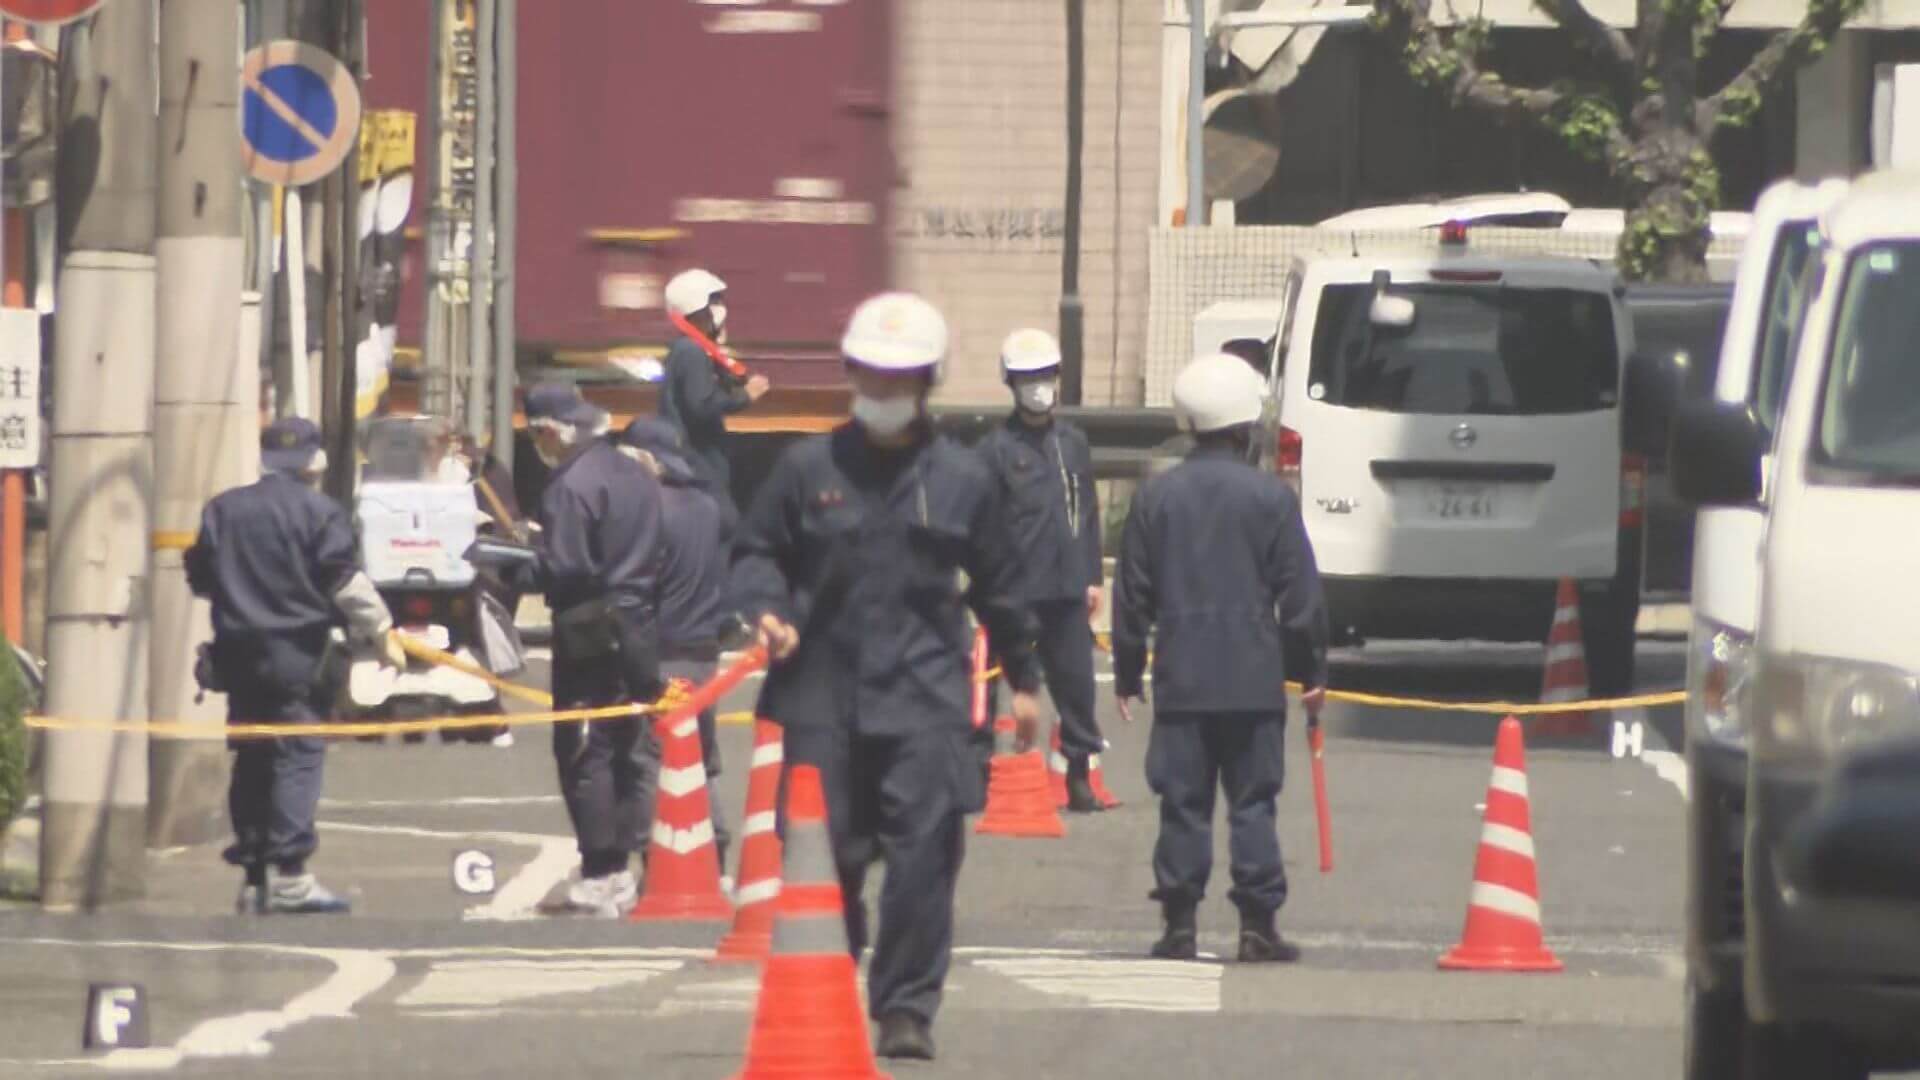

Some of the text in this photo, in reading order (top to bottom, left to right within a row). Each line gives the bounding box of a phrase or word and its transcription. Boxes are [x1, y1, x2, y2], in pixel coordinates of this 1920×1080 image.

[1612, 720, 1643, 758] H
[454, 850, 494, 893] G
[98, 988, 136, 1044] F
